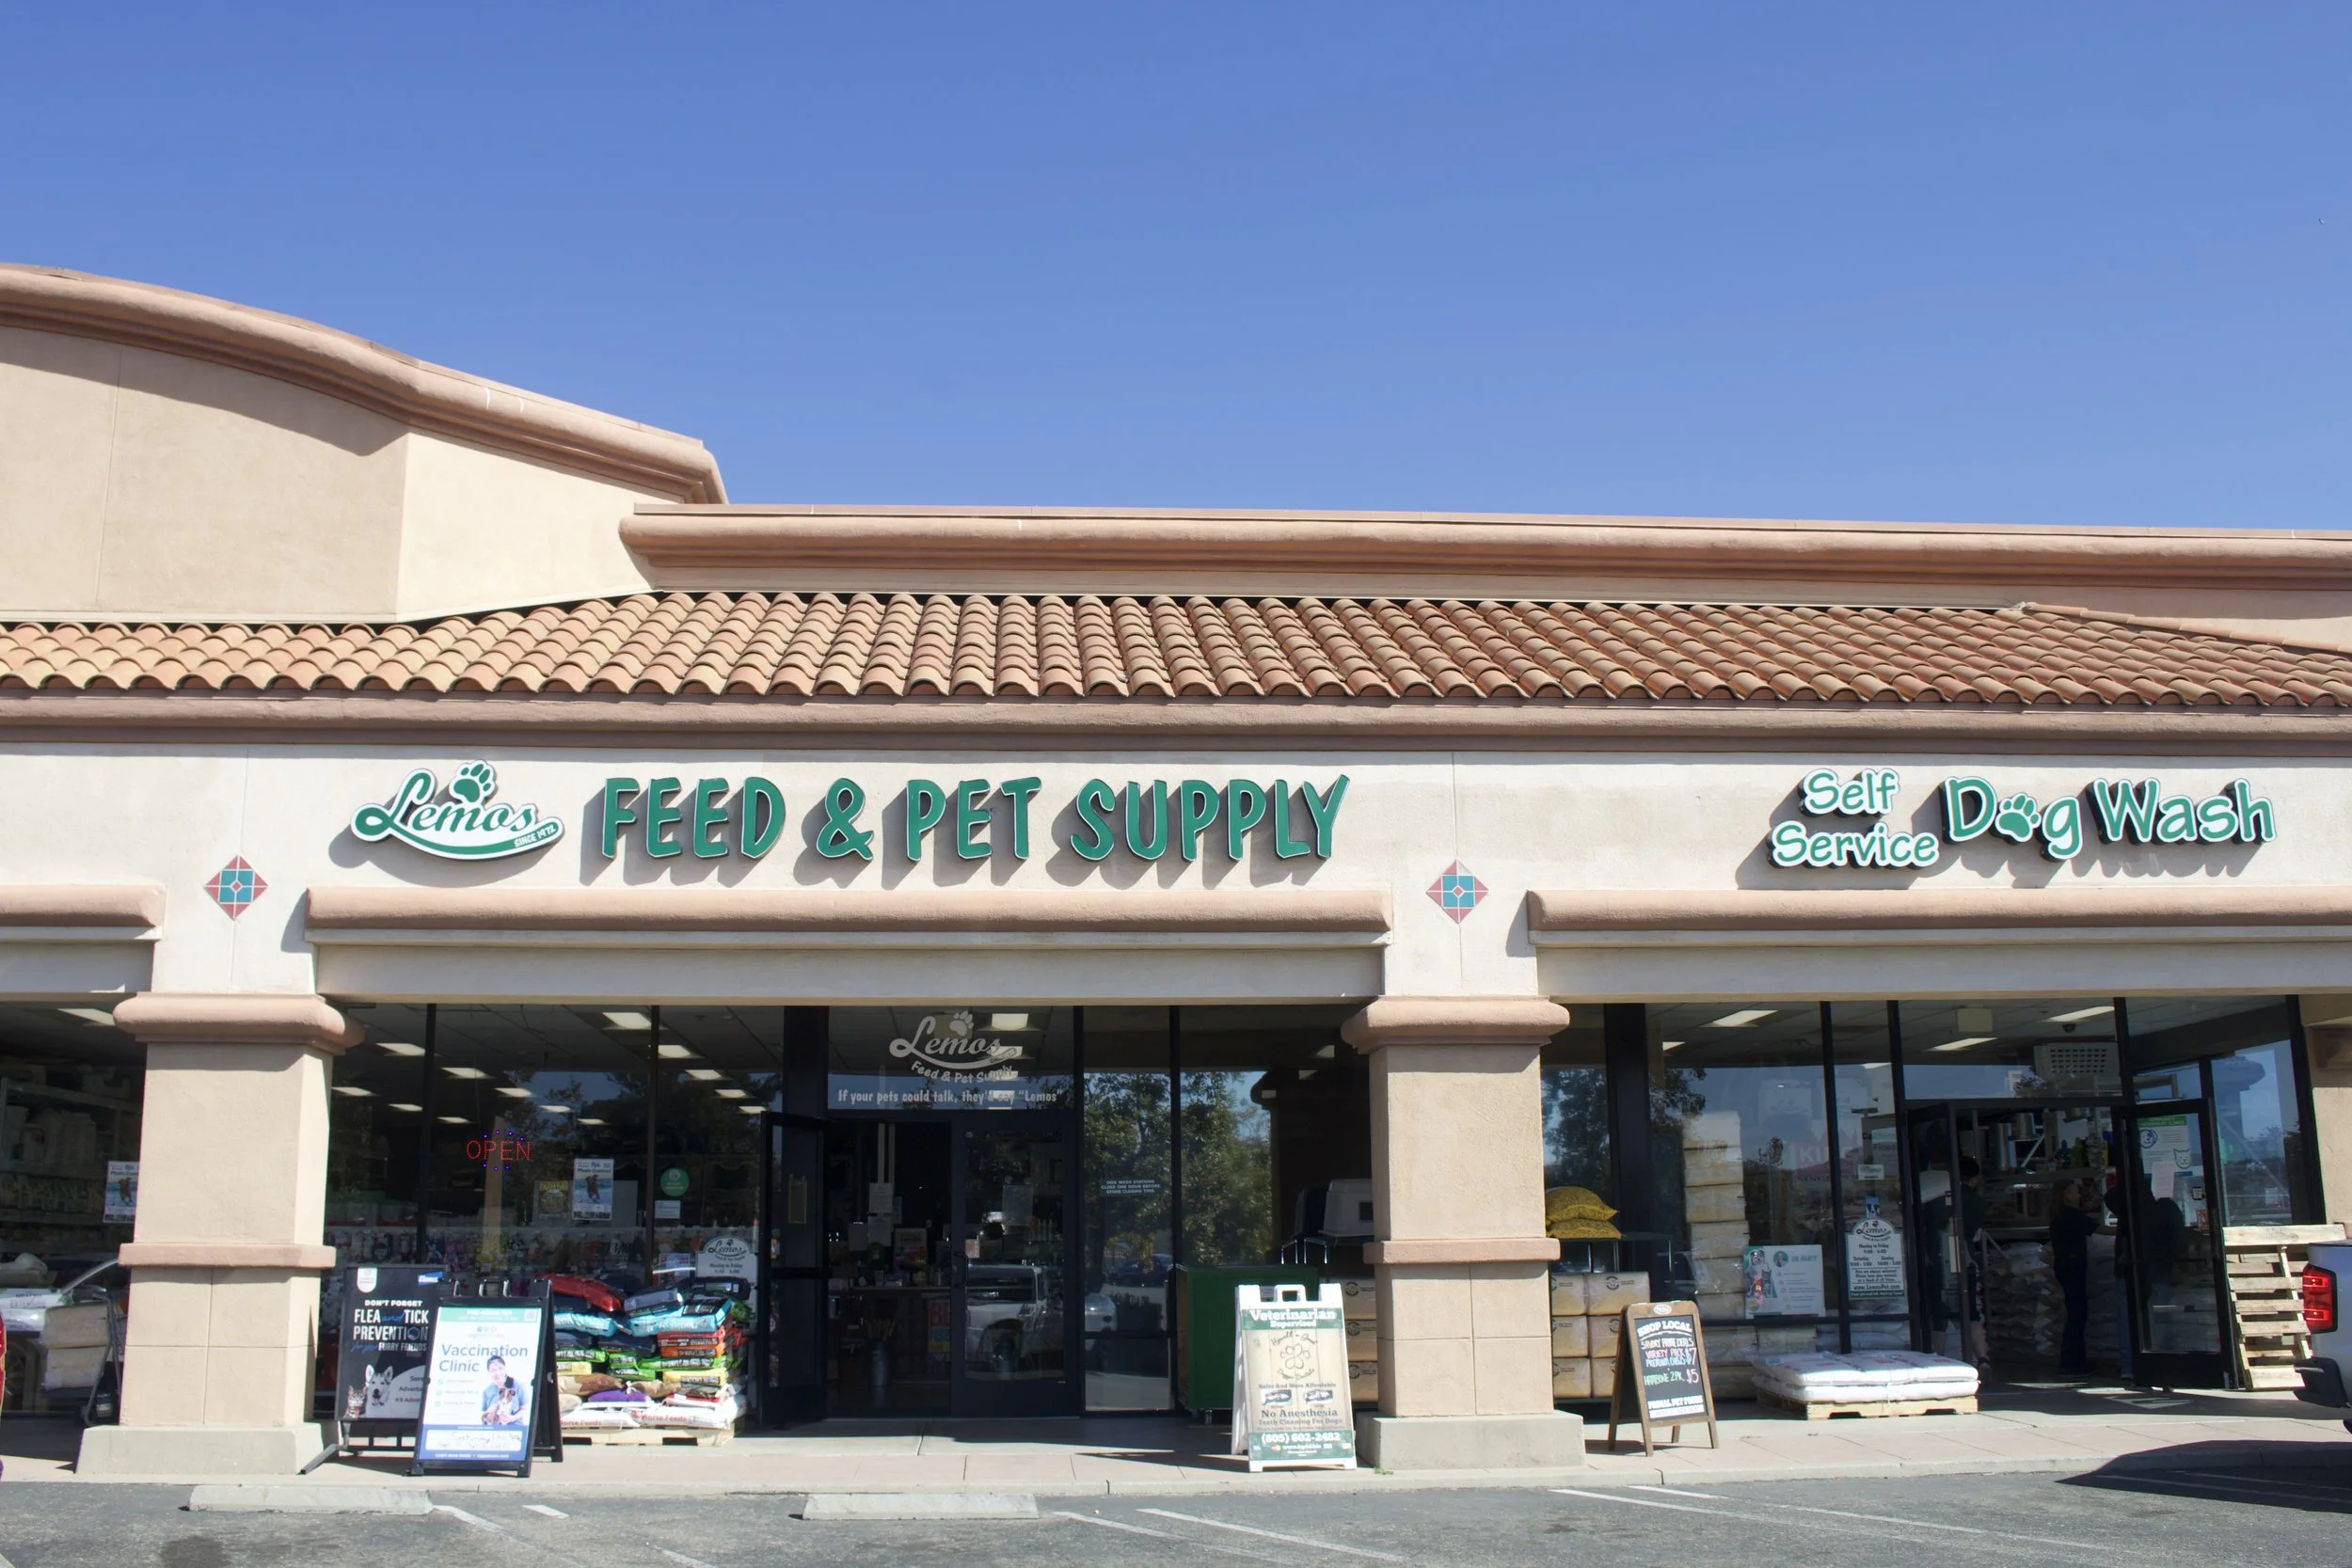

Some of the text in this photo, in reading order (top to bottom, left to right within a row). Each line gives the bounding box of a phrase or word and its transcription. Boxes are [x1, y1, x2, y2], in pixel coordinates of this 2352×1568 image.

[1804, 769, 1899, 814] Self
[354, 770, 546, 848] Lemos
[2094, 778, 2276, 842] Wash
[602, 773, 1350, 862] FEED & PET SUPPLY
[514, 825, 557, 847] SINCE 1972
[1773, 822, 1938, 864] Service
[889, 1016, 1012, 1069] Lemos
[911, 1060, 938, 1081] Feed
[941, 1071, 951, 1082] &
[954, 1071, 975, 1084] Pet
[838, 1089, 849, 1101] If
[850, 1092, 874, 1105] your
[876, 1091, 899, 1104] pets
[901, 1089, 930, 1101] could
[932, 1089, 958, 1103] talk,
[466, 1139, 532, 1162] OPEN
[708, 1241, 747, 1257] Lemos
[355, 1308, 381, 1323] FLEA
[405, 1308, 429, 1324] TICK
[1249, 1308, 1336, 1321] Veterinarian
[353, 1325, 429, 1340] PREVENTION
[1637, 1321, 1692, 1337] SHOP LOCAL
[378, 1342, 399, 1352] FURRY
[400, 1342, 427, 1352] FRIENDS
[441, 1343, 528, 1356] Vaccination
[439, 1360, 480, 1372] Clinic
[1686, 1369, 1699, 1385] $5
[1262, 1408, 1338, 1418] No Anesthesia
[1325, 1417, 1343, 1425] Dogs
